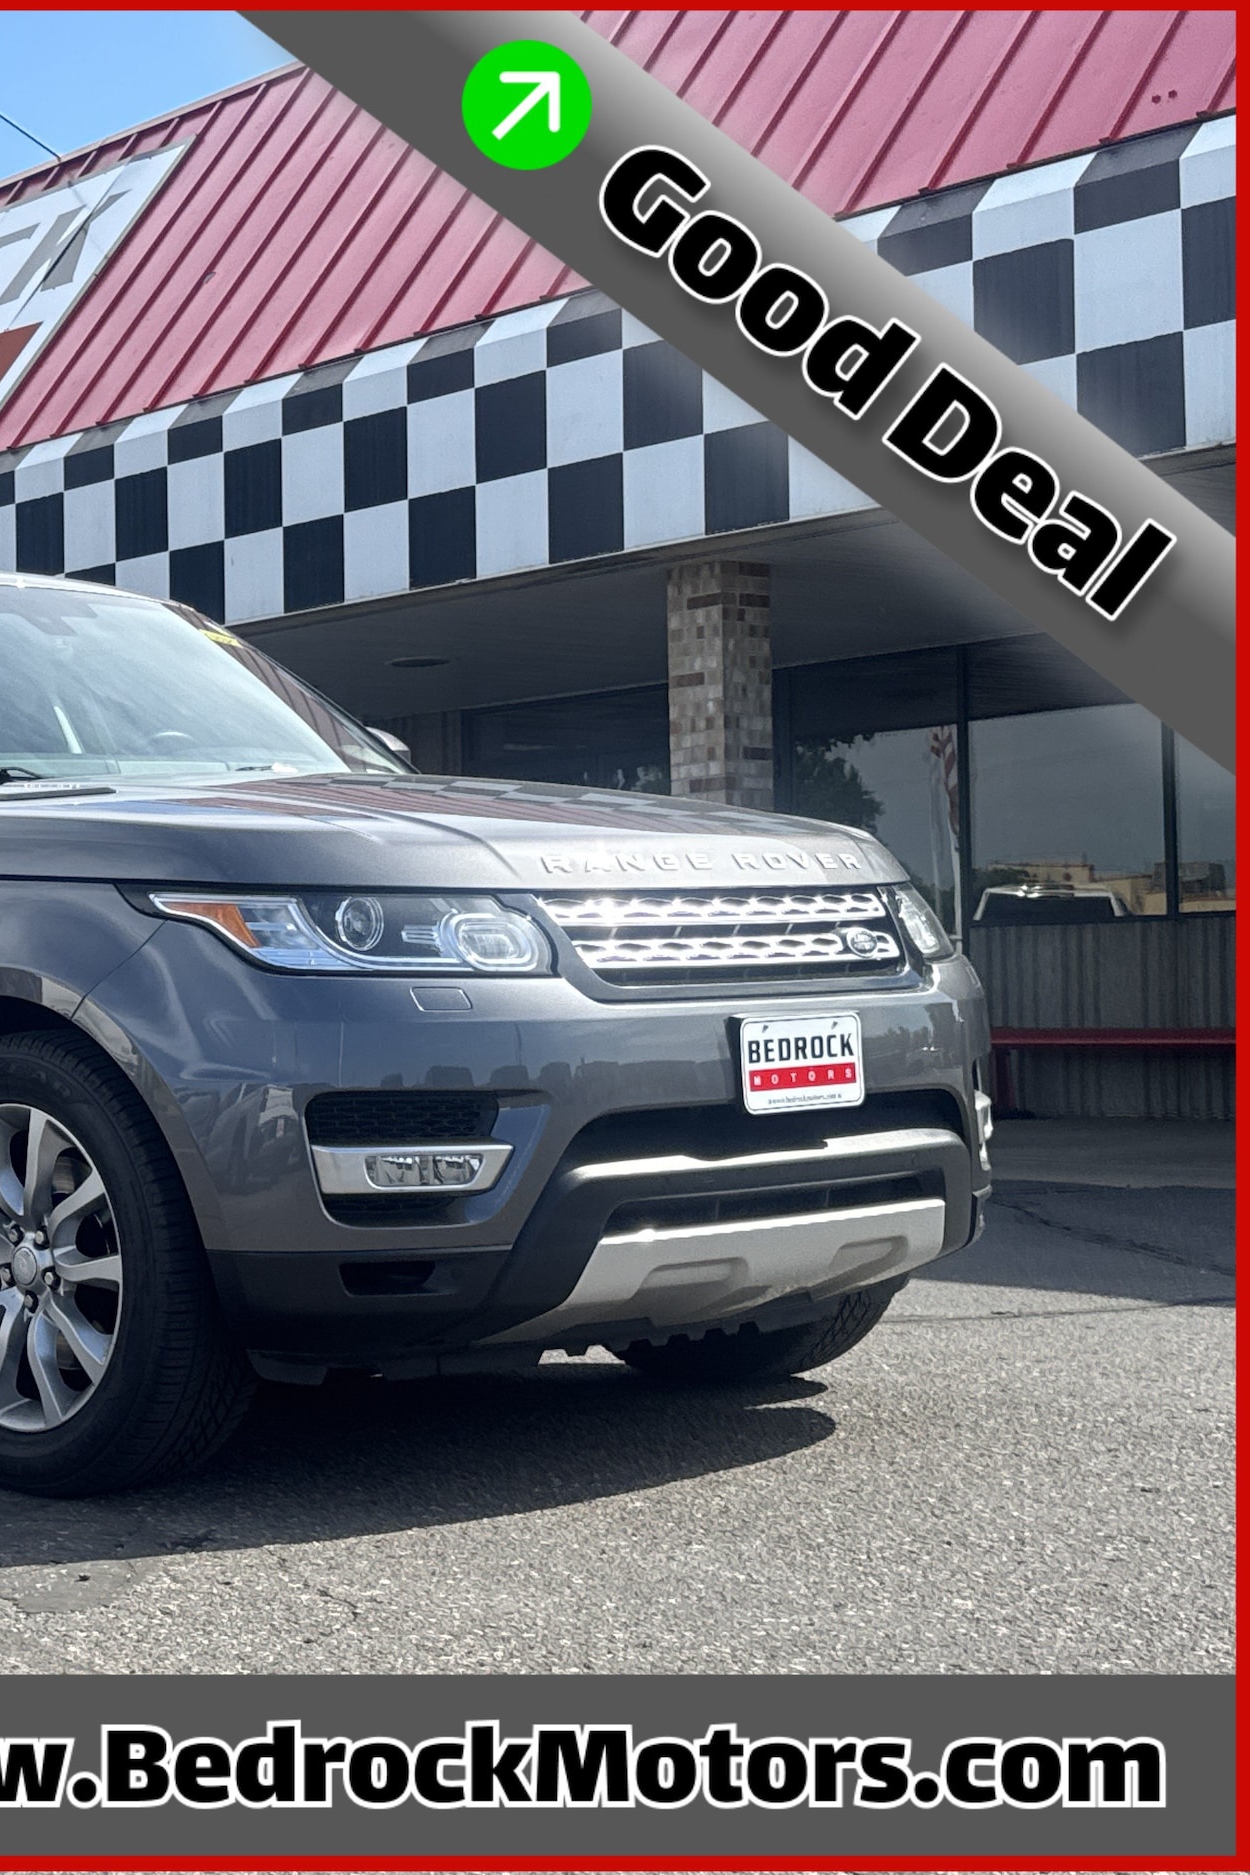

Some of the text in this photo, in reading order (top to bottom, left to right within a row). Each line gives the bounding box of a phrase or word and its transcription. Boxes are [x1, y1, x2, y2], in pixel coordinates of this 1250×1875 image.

[539, 852, 861, 874] RANGE ROVER
[748, 1033, 854, 1064] BEDROCK
[753, 1068, 853, 1086] MOTORS
